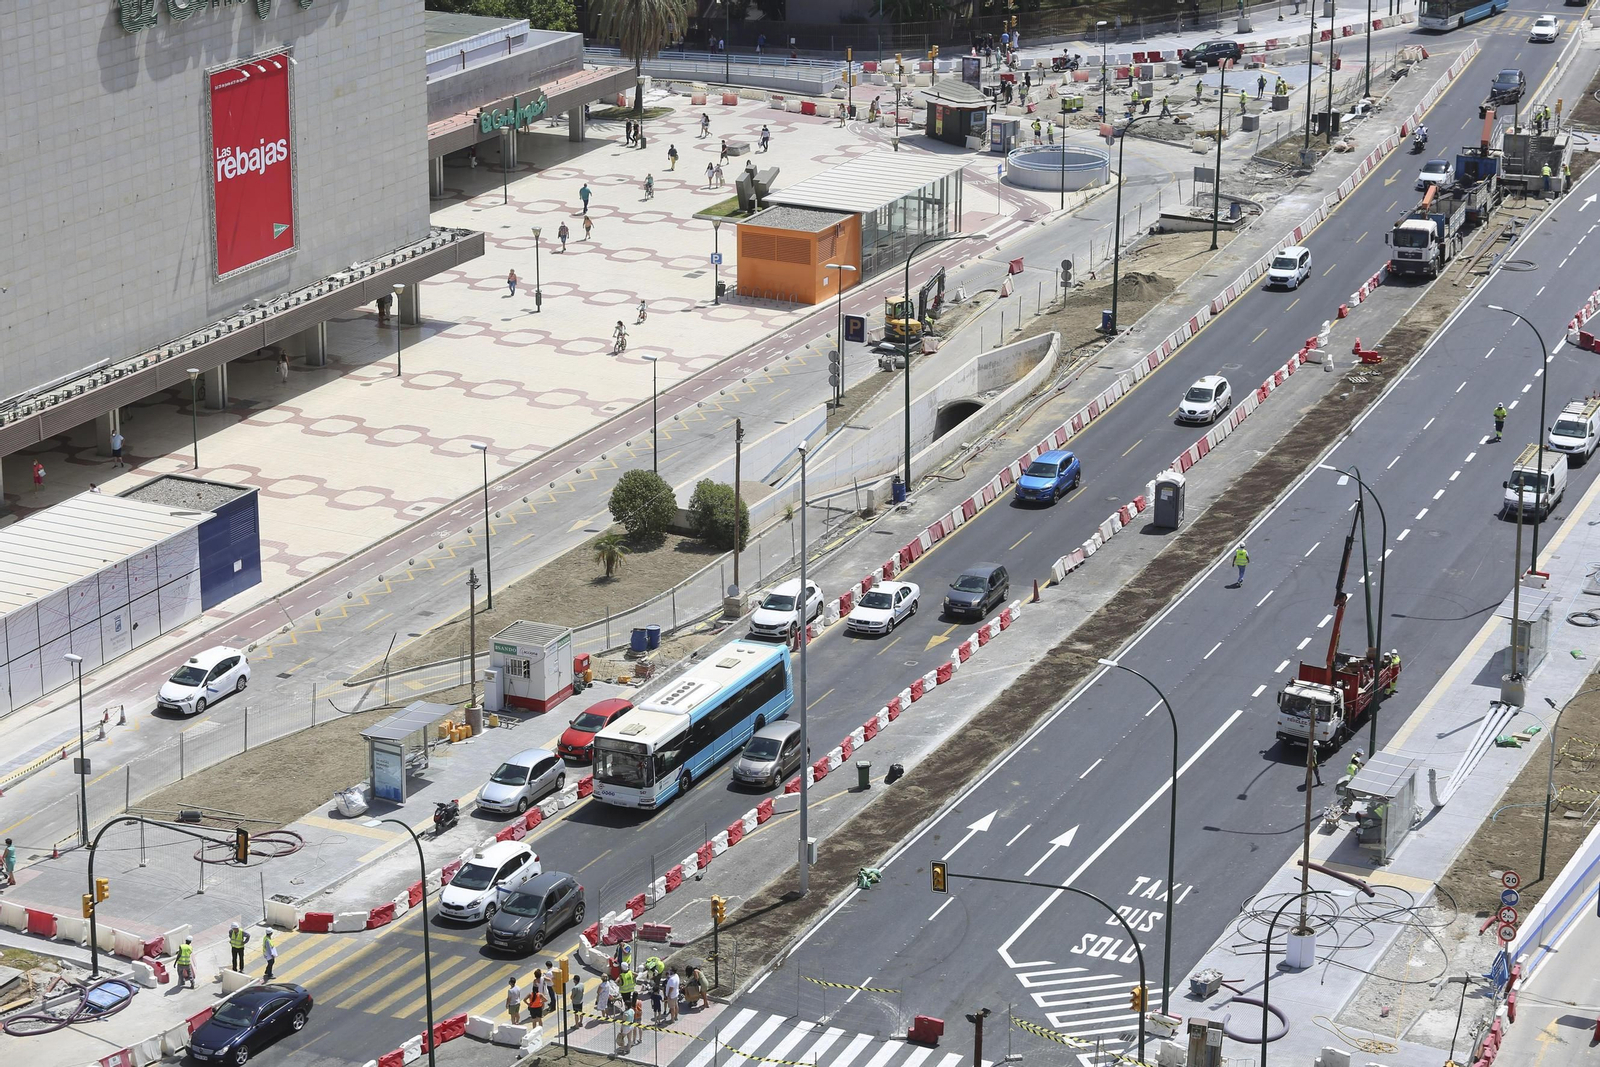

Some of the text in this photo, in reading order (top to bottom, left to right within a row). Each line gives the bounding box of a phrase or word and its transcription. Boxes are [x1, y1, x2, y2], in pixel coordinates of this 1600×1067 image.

[491, 107, 515, 130] Corte
[514, 94, 548, 130] Inglés
[216, 146, 232, 160] Las
[216, 138, 288, 182] rebajas
[713, 254, 720, 264] P
[849, 318, 862, 335] P
[497, 644, 517, 653] SANDO
[1127, 875, 1194, 905] TAXI
[1505, 876, 1517, 884] 20
[1105, 905, 1164, 932] BUS
[1069, 933, 1147, 964] SOLO
